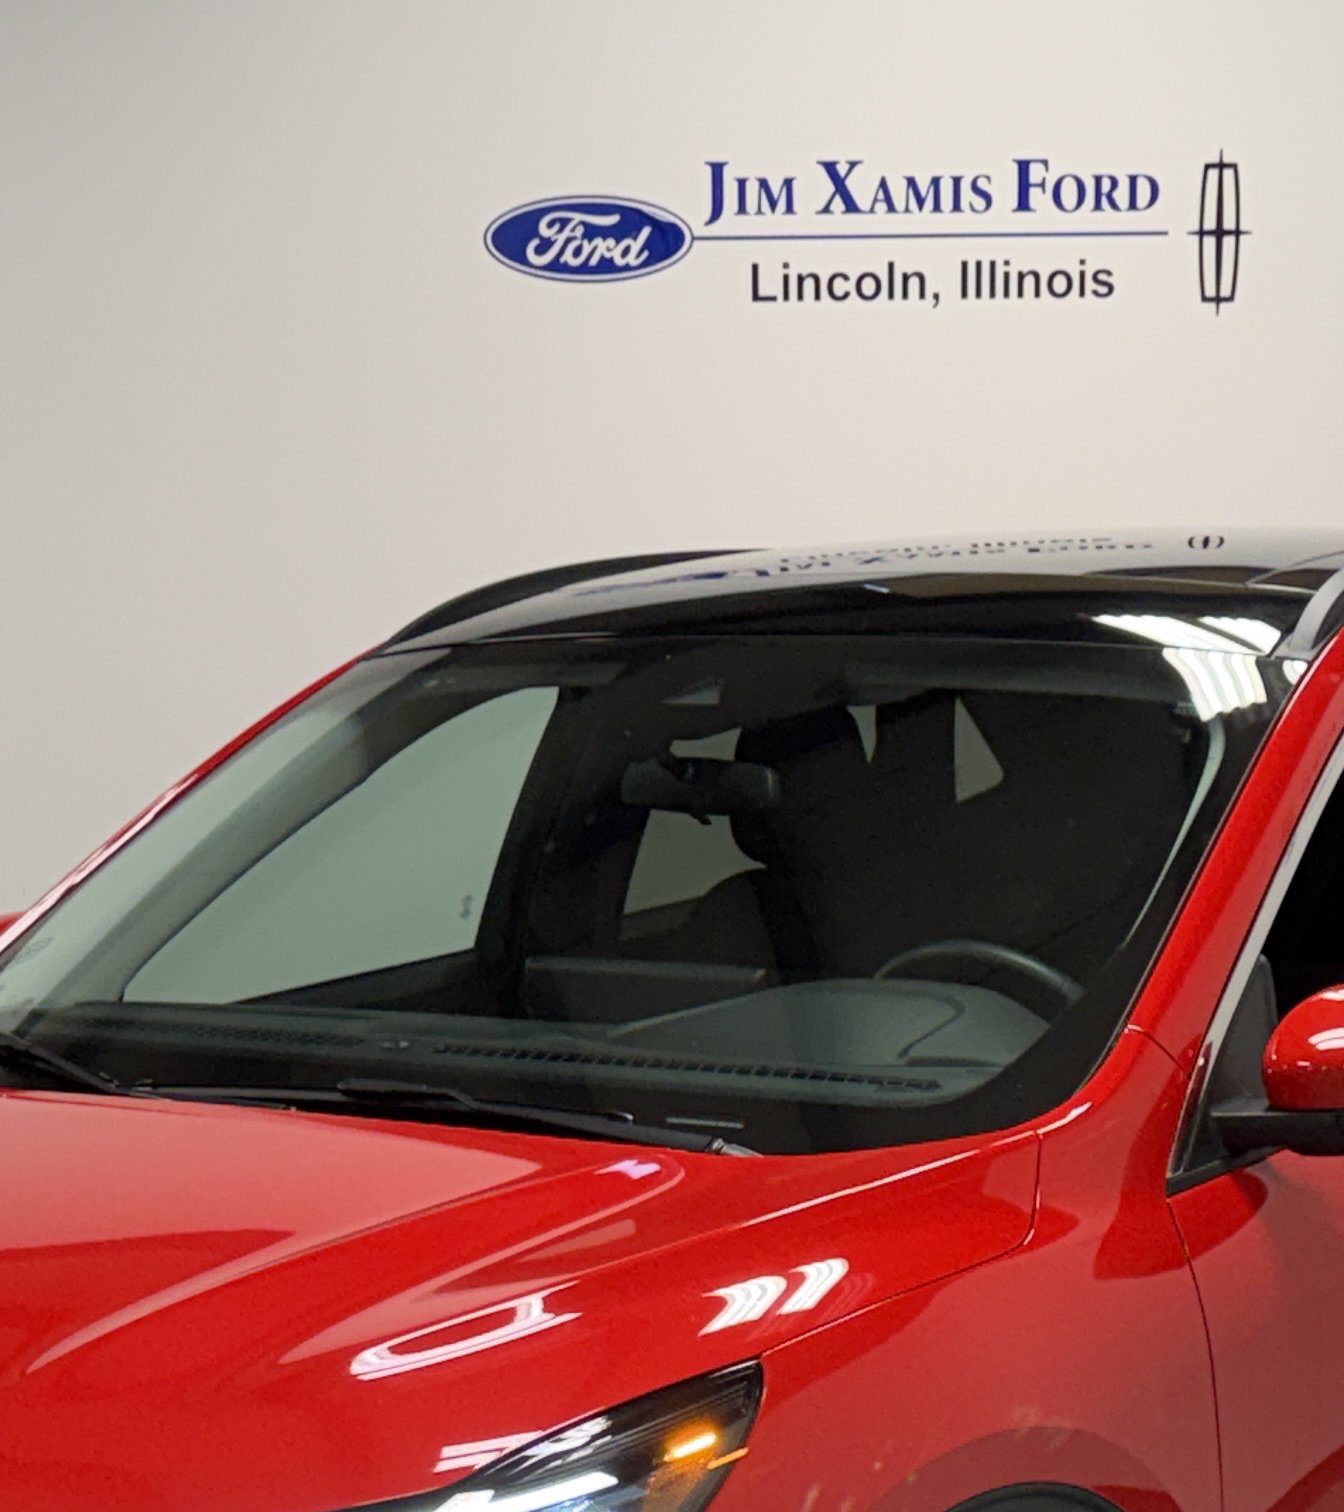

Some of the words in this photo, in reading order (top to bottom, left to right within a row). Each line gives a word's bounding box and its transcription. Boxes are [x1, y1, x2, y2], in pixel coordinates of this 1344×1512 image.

[703, 160, 798, 228] JIM
[816, 159, 995, 216] XAMIS
[1011, 158, 1160, 213] FORD
[526, 211, 650, 270] Ford
[750, 261, 942, 310] Lincoln,
[959, 260, 1116, 301] Illinois
